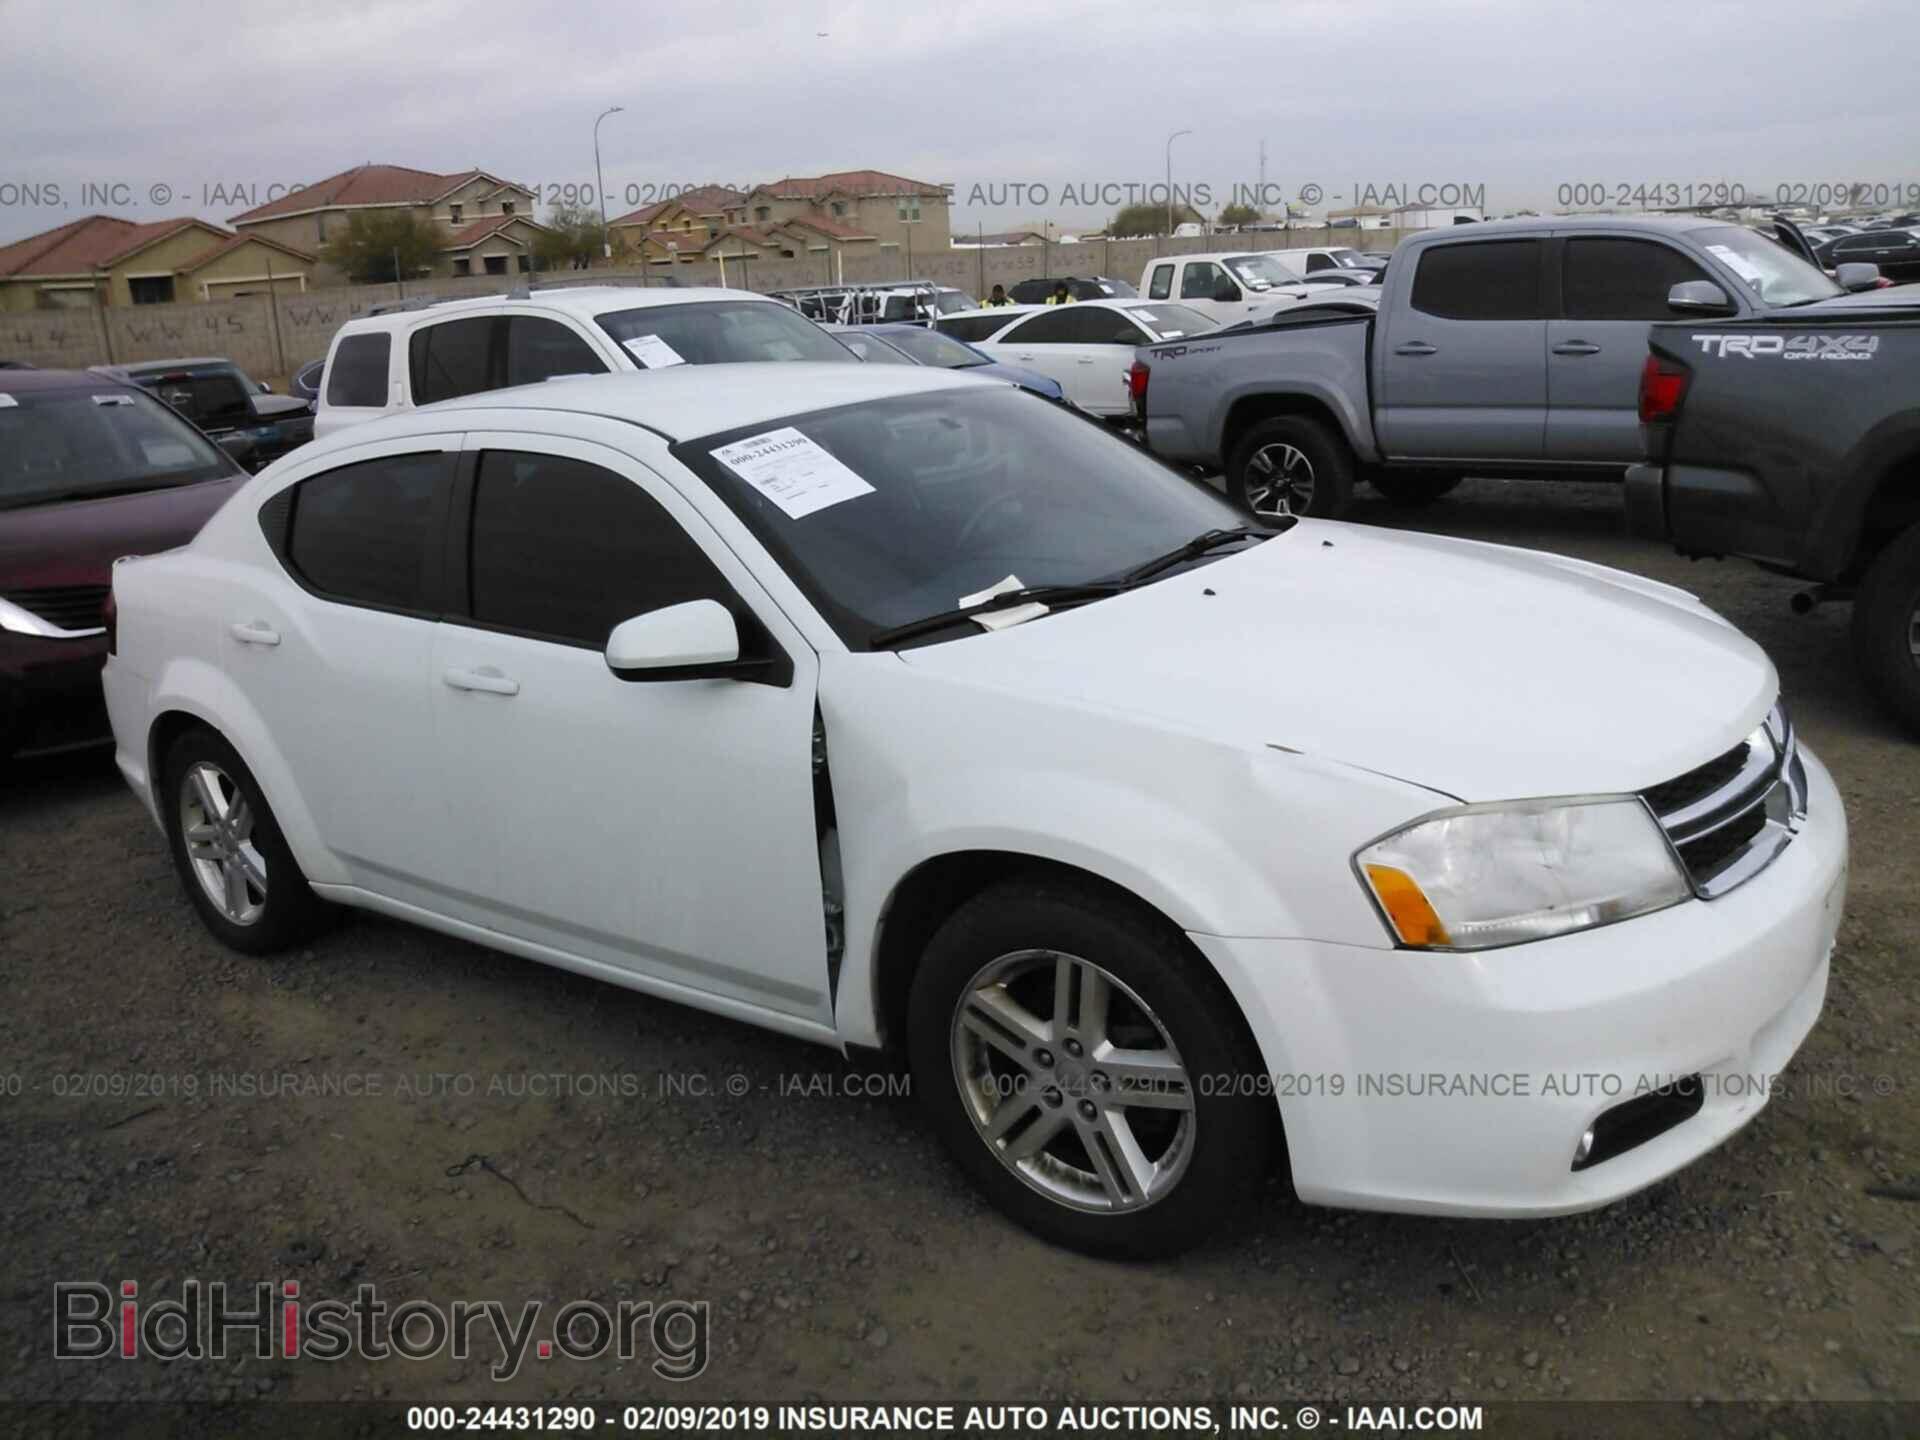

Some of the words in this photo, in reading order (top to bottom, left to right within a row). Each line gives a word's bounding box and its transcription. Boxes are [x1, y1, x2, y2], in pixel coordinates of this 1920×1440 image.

[1150, 346, 1187, 360] TRD
[1692, 334, 1785, 358] TRD
[1783, 352, 1818, 360] OFF
[1819, 351, 1873, 361] ROAD
